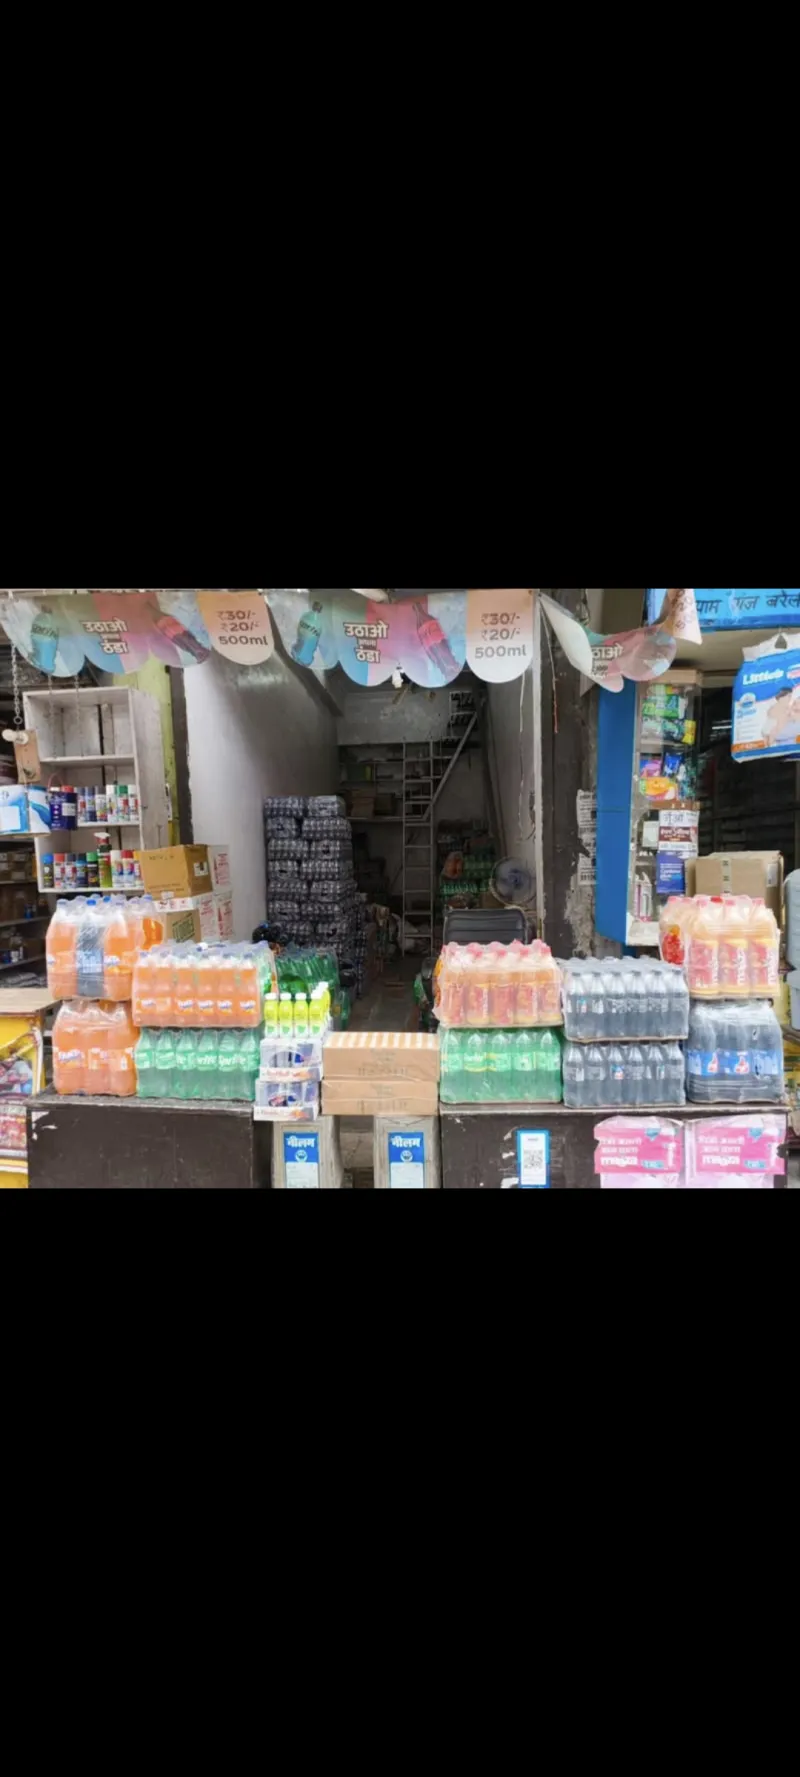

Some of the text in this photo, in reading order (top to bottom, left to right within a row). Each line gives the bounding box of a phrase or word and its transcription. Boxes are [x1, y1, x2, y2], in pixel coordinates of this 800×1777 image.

[81, 617, 128, 632] उठाओ
[343, 619, 388, 638] उठाओ
[101, 640, 128, 654] ठंडा
[218, 636, 268, 645] 500ml
[356, 646, 380, 663] ठंडा
[475, 644, 527, 659] 500ml
[591, 643, 624, 659] ठाओ
